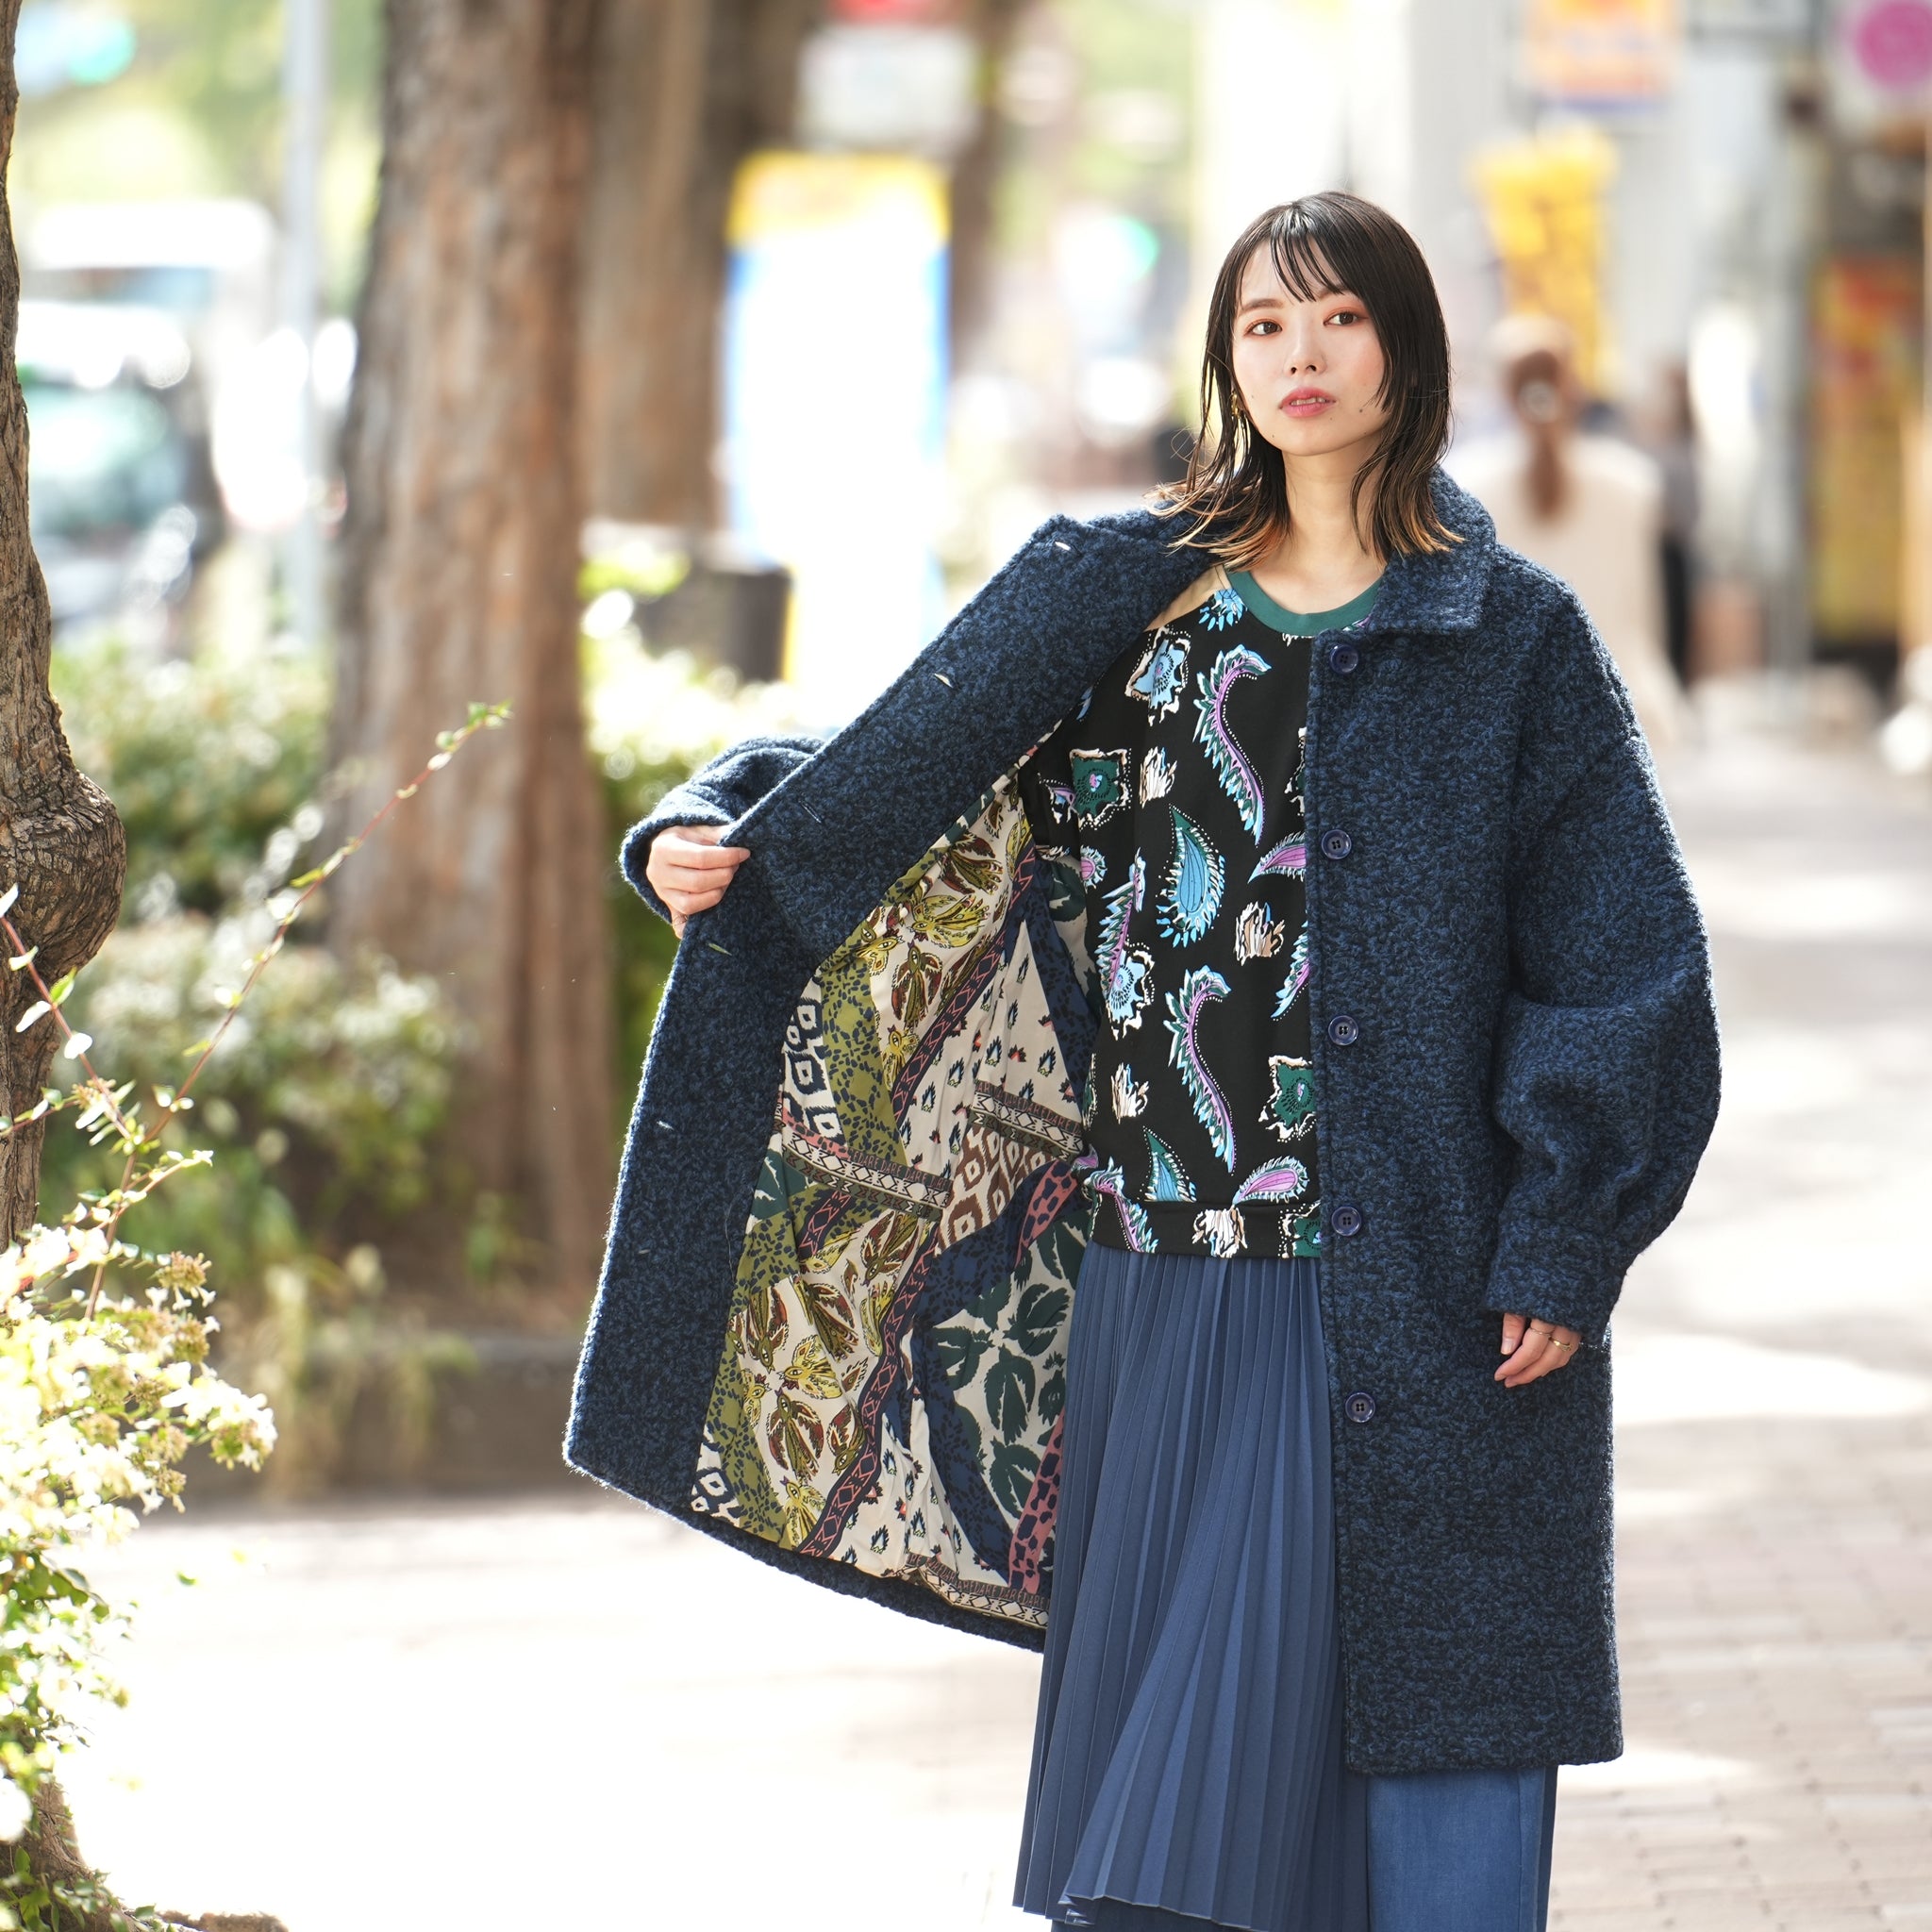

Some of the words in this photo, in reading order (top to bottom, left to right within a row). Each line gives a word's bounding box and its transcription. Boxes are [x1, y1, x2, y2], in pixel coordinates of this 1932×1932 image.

[857, 1152, 879, 1170] DARE
[880, 1159, 903, 1178] DARE
[905, 1167, 928, 1186] DARE
